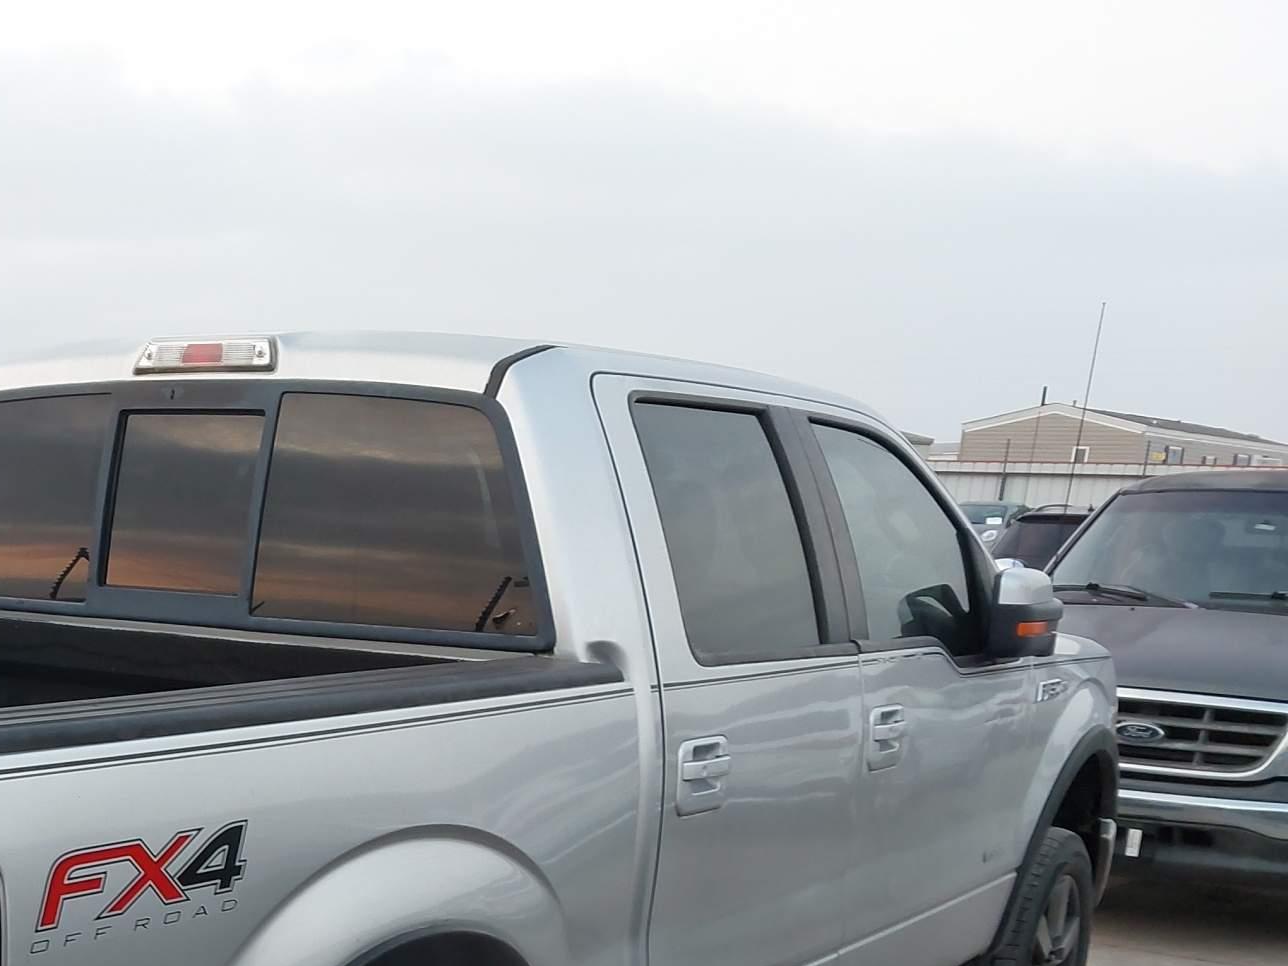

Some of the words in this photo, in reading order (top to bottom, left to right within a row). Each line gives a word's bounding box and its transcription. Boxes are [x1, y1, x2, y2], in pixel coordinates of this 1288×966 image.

[34, 819, 249, 934] FX4
[29, 925, 113, 955] OFF
[133, 898, 239, 932] ROAD
